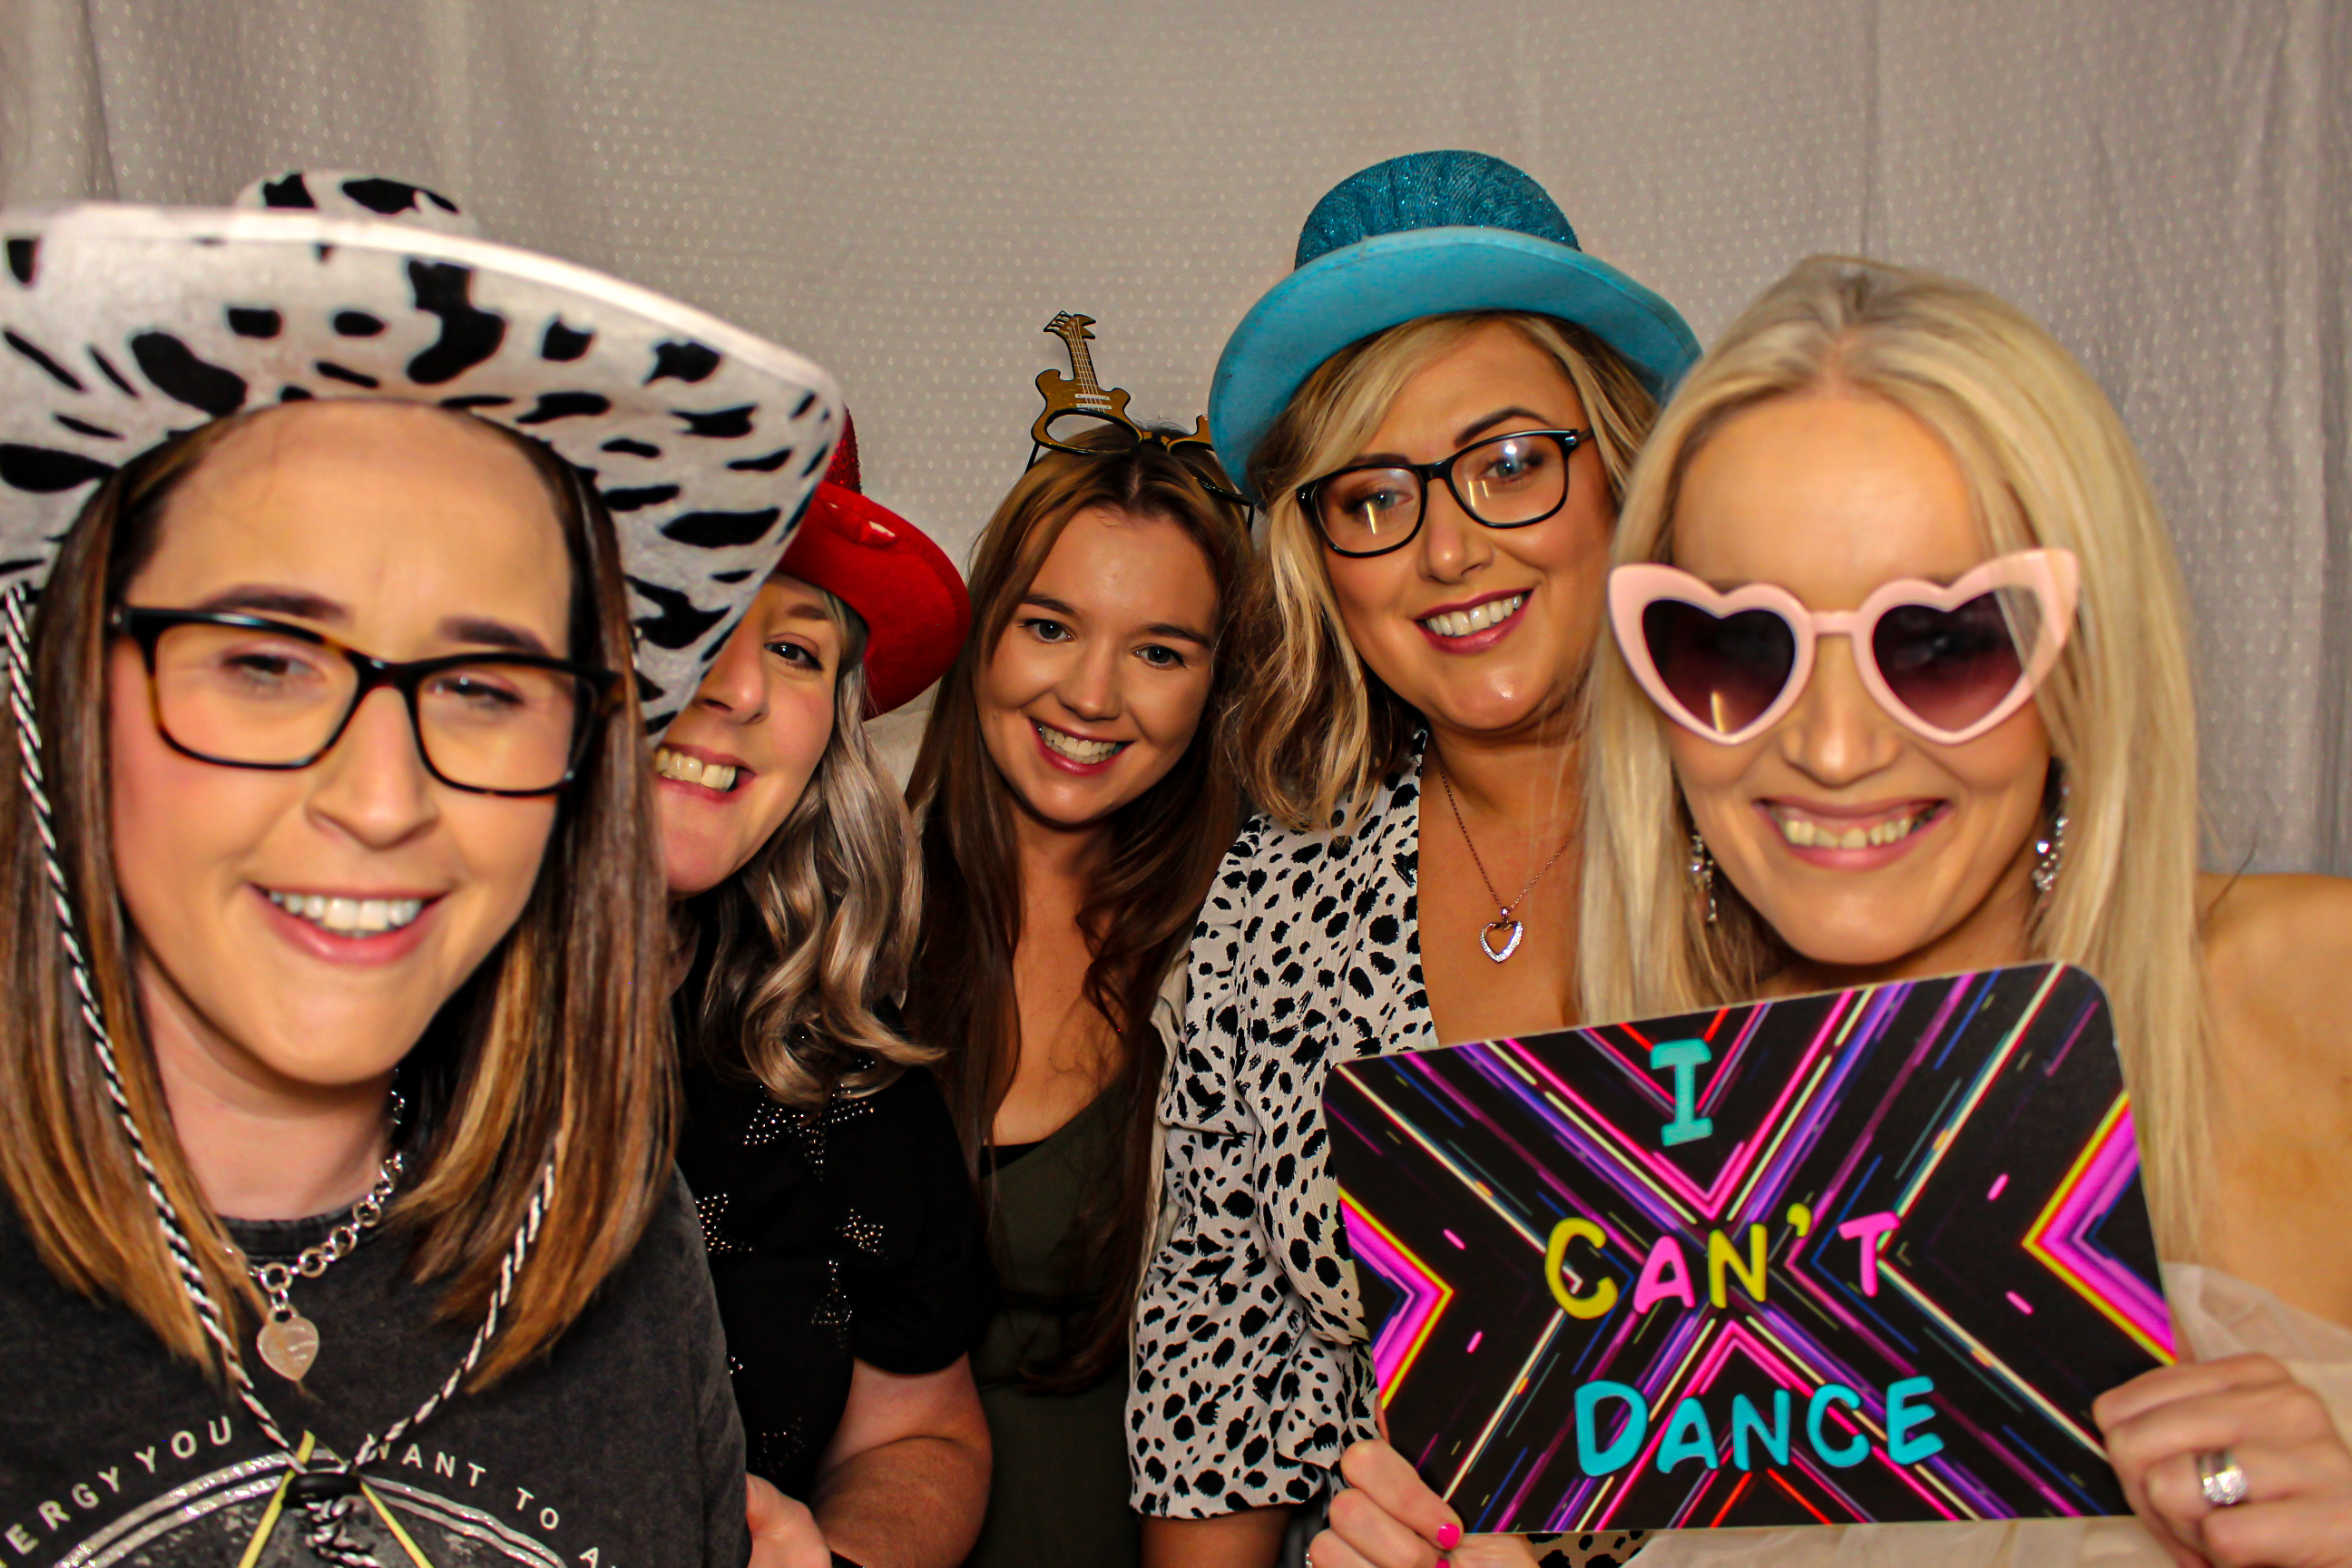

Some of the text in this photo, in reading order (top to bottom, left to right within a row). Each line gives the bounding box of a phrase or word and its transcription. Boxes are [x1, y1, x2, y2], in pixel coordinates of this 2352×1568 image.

[1650, 1039, 1712, 1146] I
[1544, 1203, 1900, 1319] CAN'T
[1574, 1376, 1944, 1476] DANCE
[0, 1463, 121, 1568] ERGY
[134, 1415, 232, 1472] YOU
[516, 1486, 560, 1531] TO
